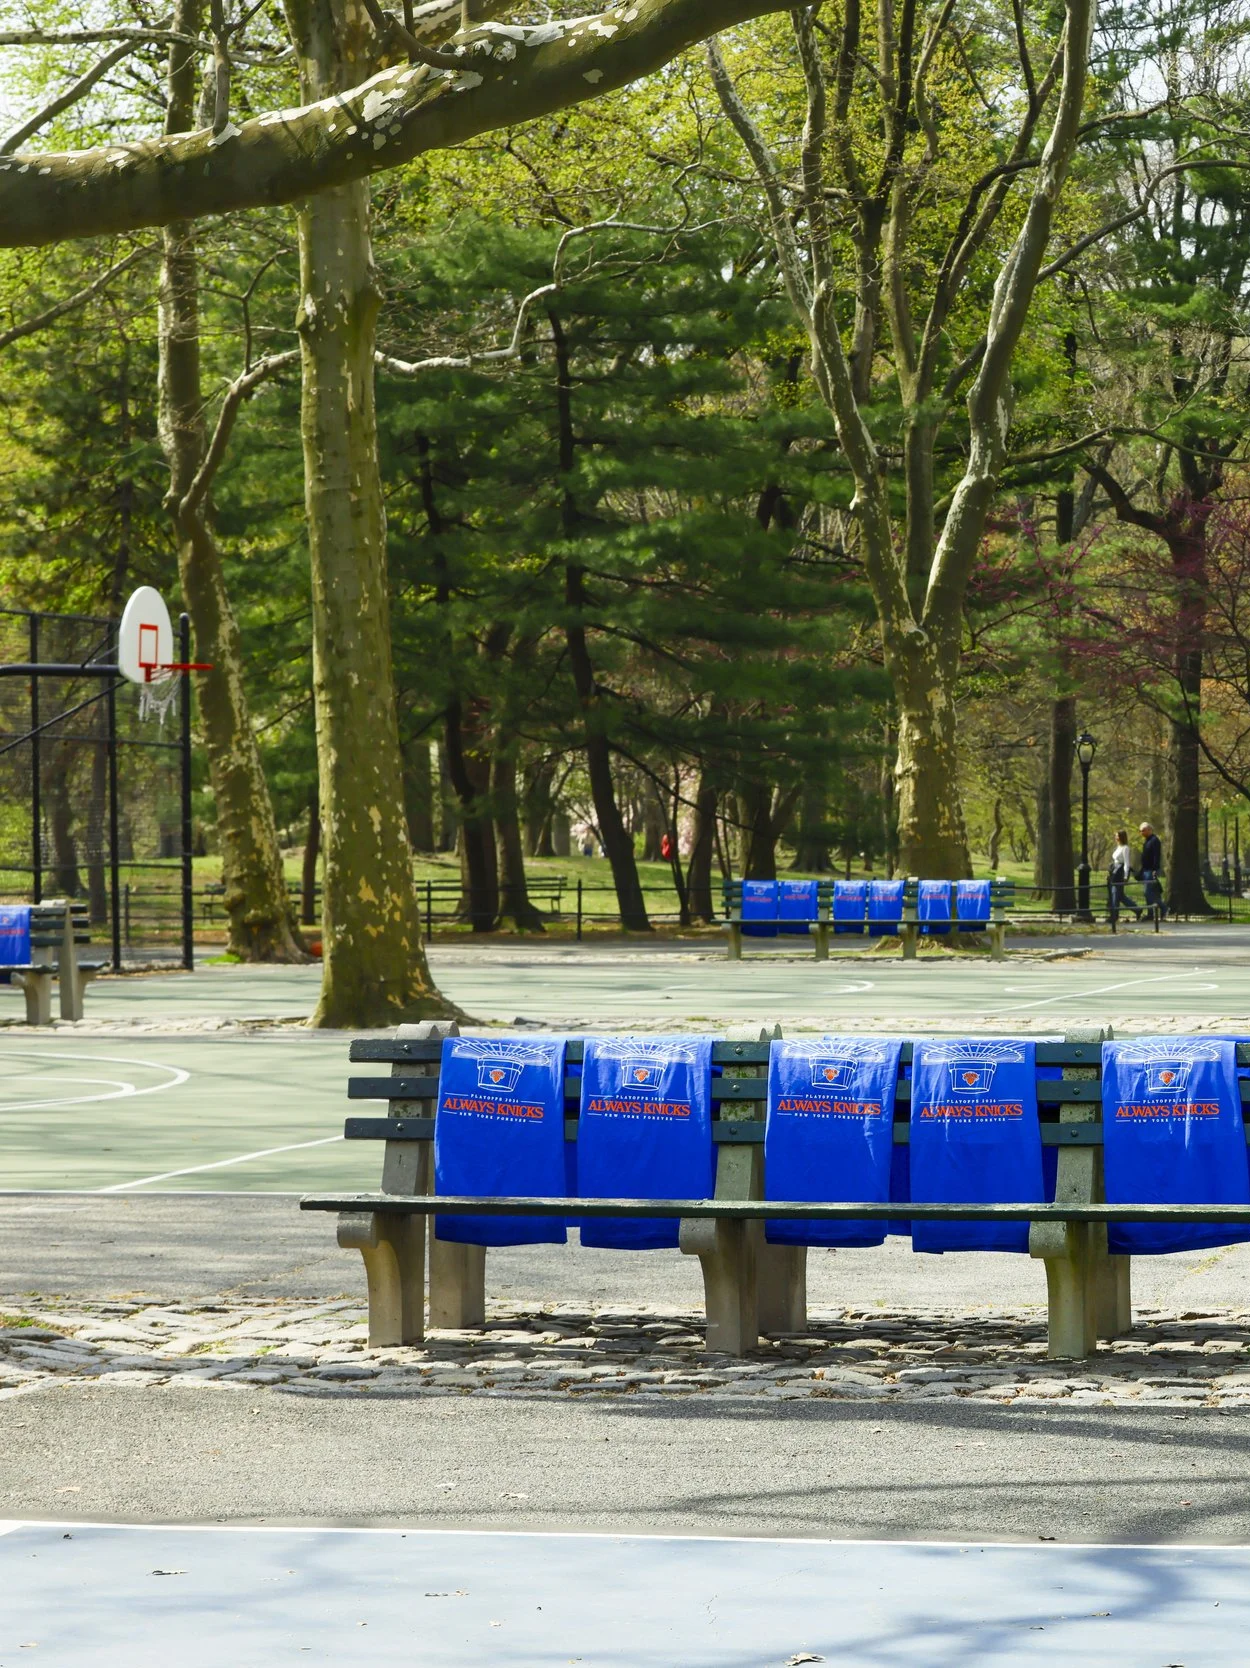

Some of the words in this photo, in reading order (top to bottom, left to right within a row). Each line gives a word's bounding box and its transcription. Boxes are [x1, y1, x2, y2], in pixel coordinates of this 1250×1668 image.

[443, 1097, 495, 1114] ALWAYS
[497, 1103, 544, 1119] KNICKS
[587, 1099, 642, 1114] ALWAYS
[643, 1102, 691, 1117] KNICKS
[777, 1099, 831, 1113] ALWAYS
[833, 1102, 881, 1115] KNICKS
[920, 1105, 973, 1118] ALWAYS
[975, 1103, 1023, 1117] KNICKS
[1115, 1105, 1170, 1117] ALWAYS
[1171, 1103, 1220, 1116] KNICKS
